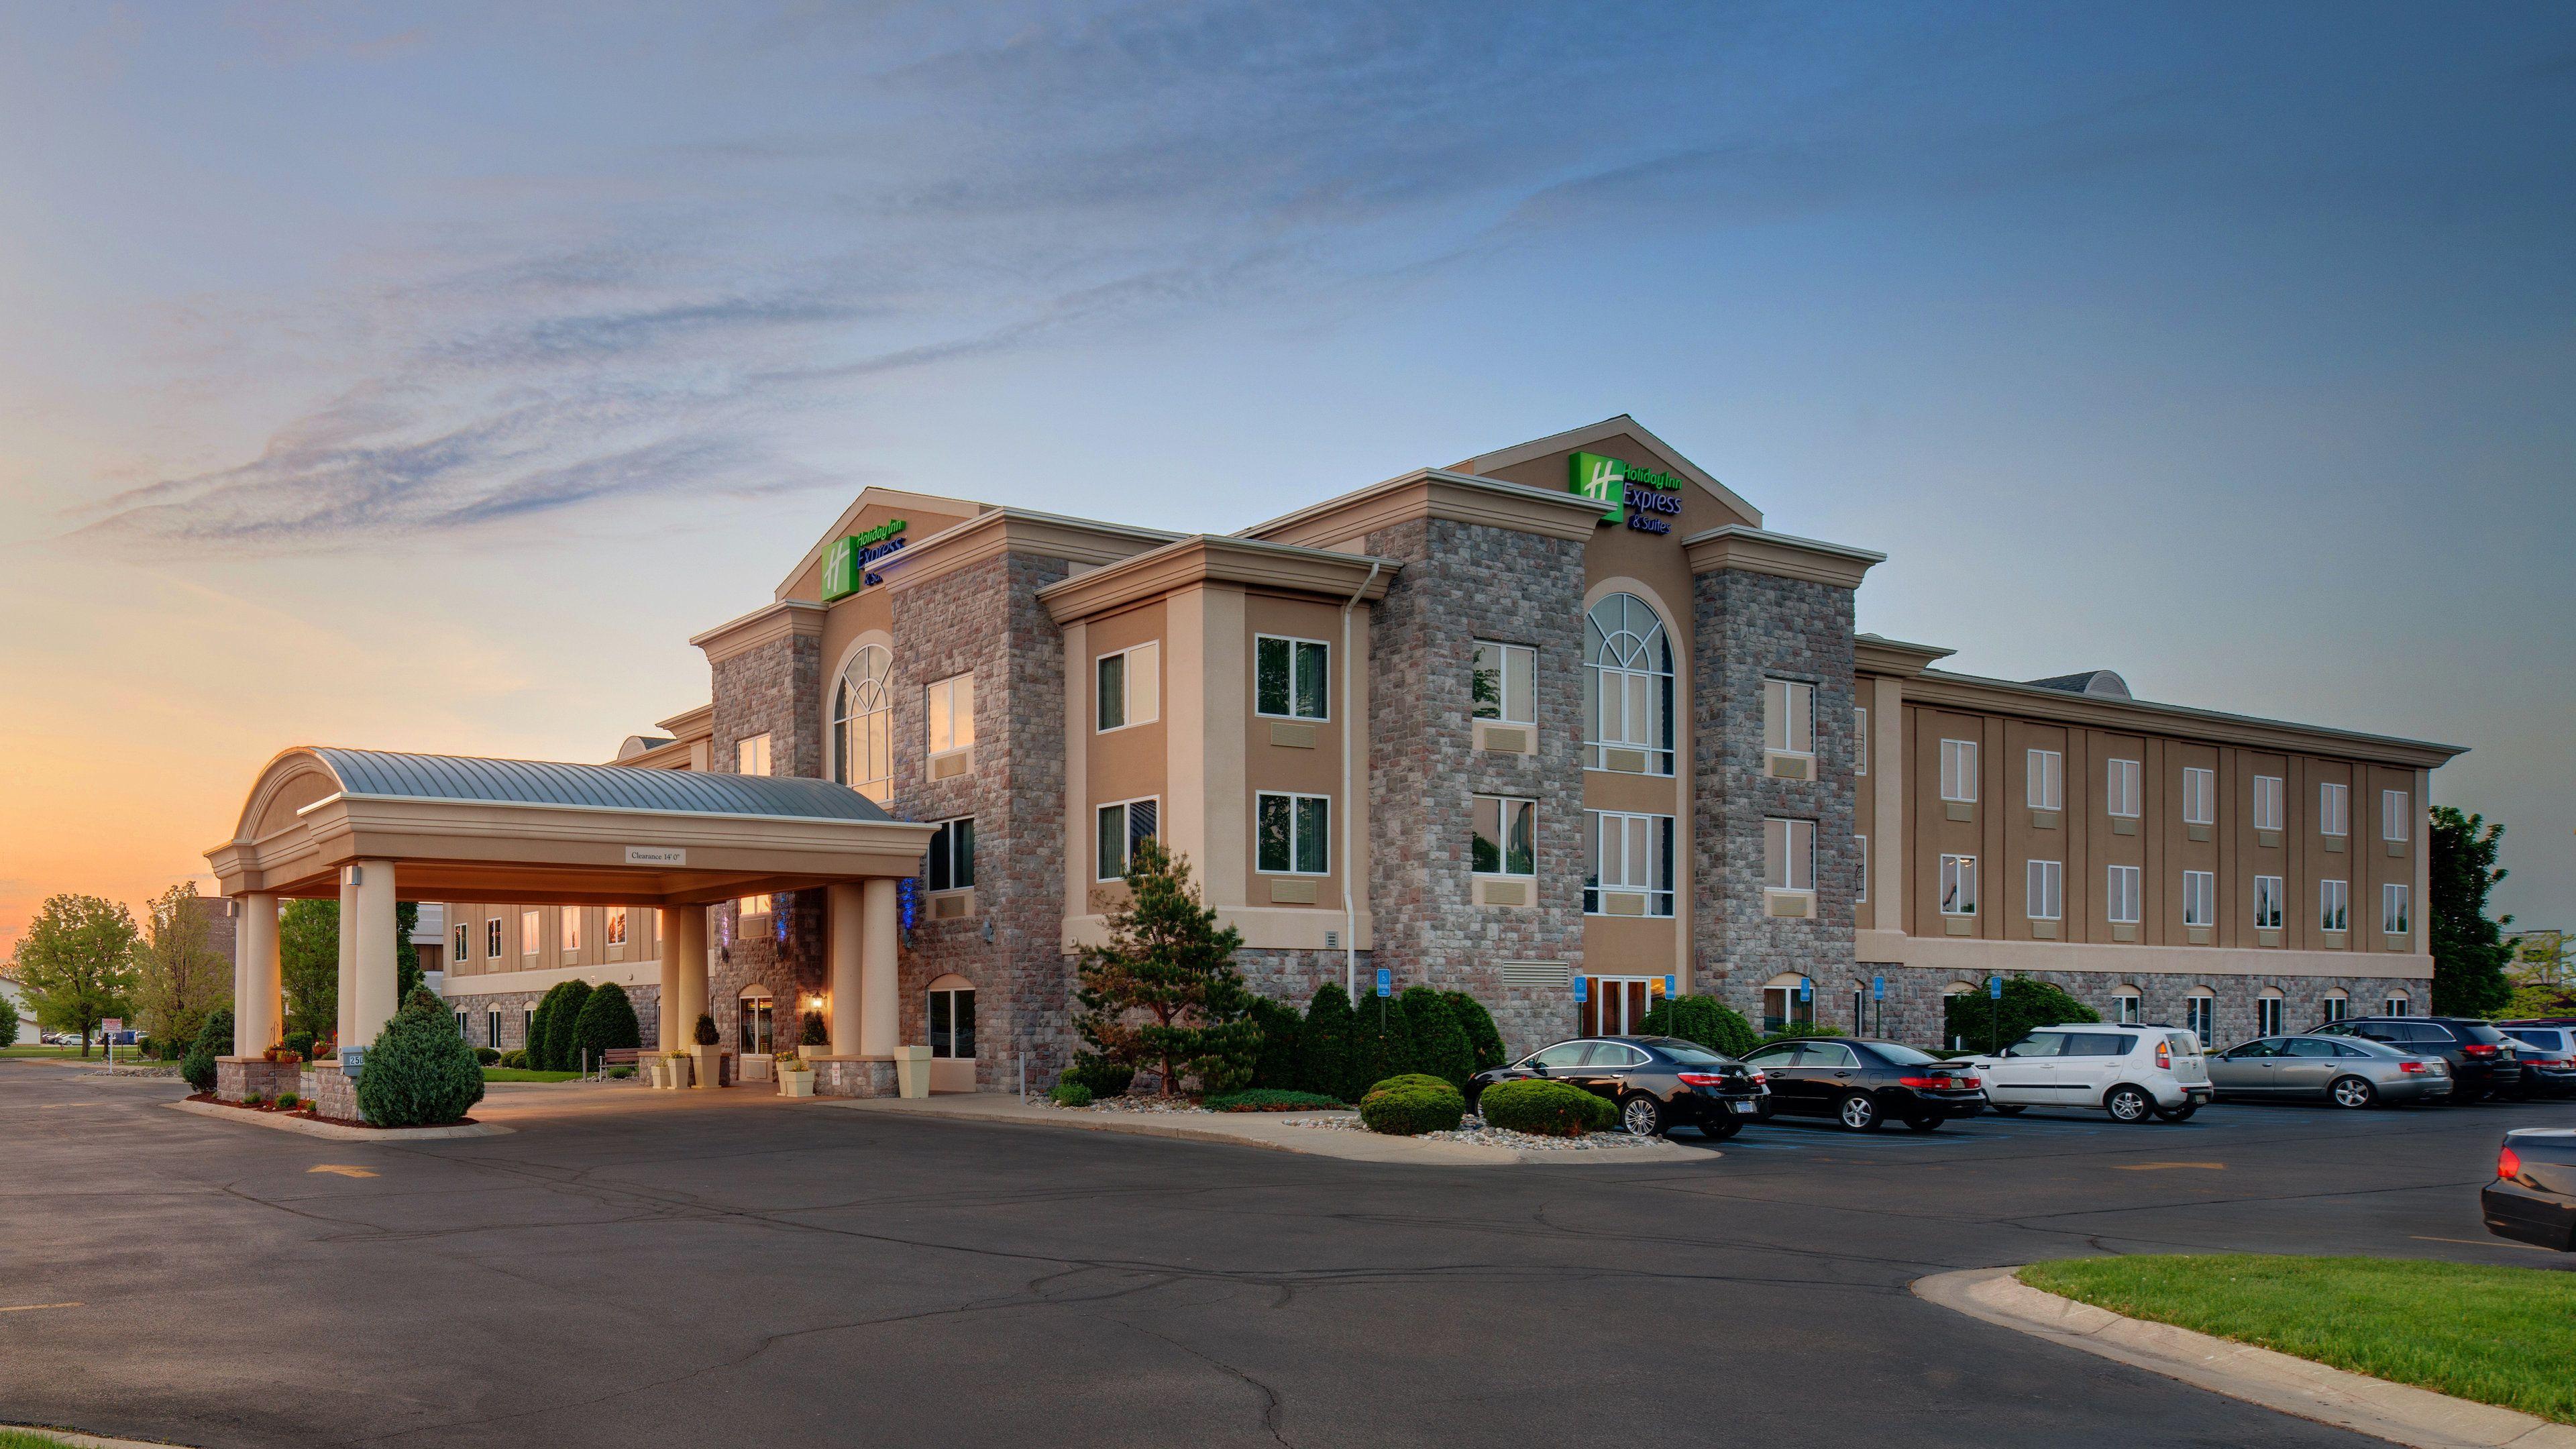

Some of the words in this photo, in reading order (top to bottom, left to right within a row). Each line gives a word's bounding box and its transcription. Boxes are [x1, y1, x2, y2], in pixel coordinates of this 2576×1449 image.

[1623, 463, 1664, 490] Holiday
[1666, 472, 1682, 490] Inn
[1623, 482, 1682, 514] Express
[857, 525, 888, 548] Holiday
[888, 519, 902, 535] Inn
[1633, 515, 1640, 529] &
[1643, 517, 1672, 534] Suites
[631, 851, 662, 860] Clearance
